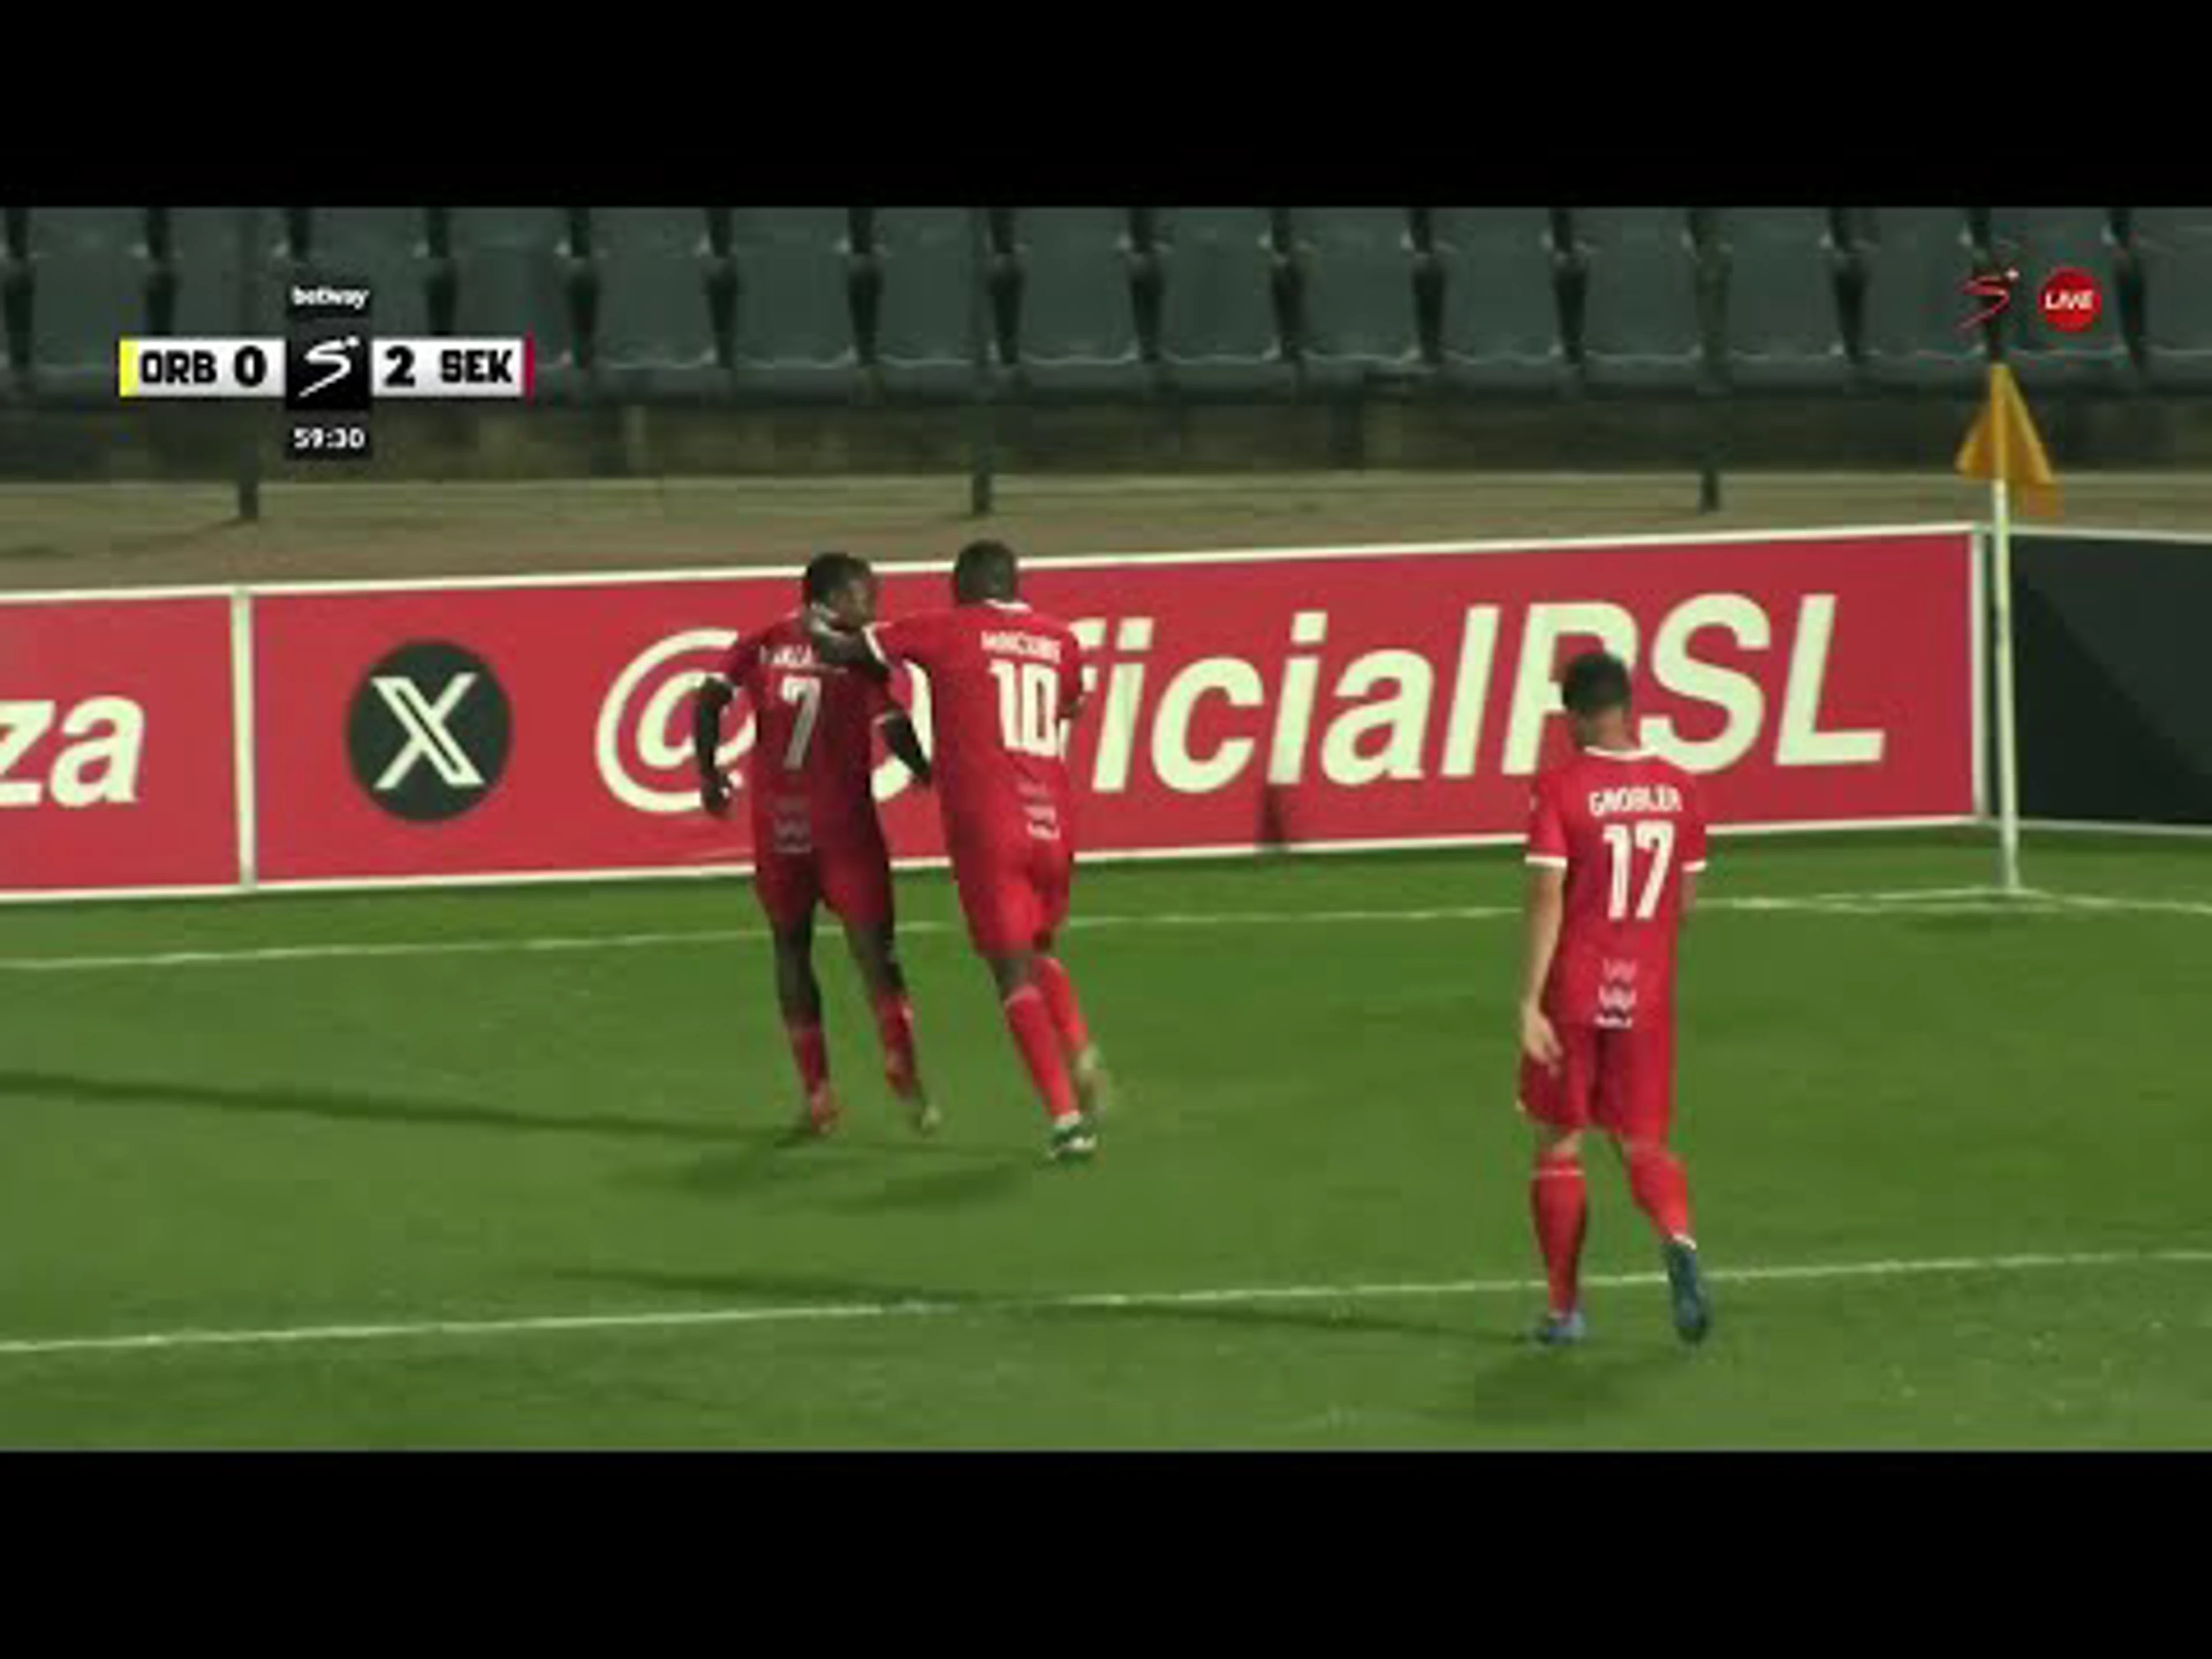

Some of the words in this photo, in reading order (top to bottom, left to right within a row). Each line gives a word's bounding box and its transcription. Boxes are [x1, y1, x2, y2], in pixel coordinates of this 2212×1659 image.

[781, 675, 821, 770] 7
[988, 658, 1059, 757] 10
[1603, 820, 1675, 921] 17
